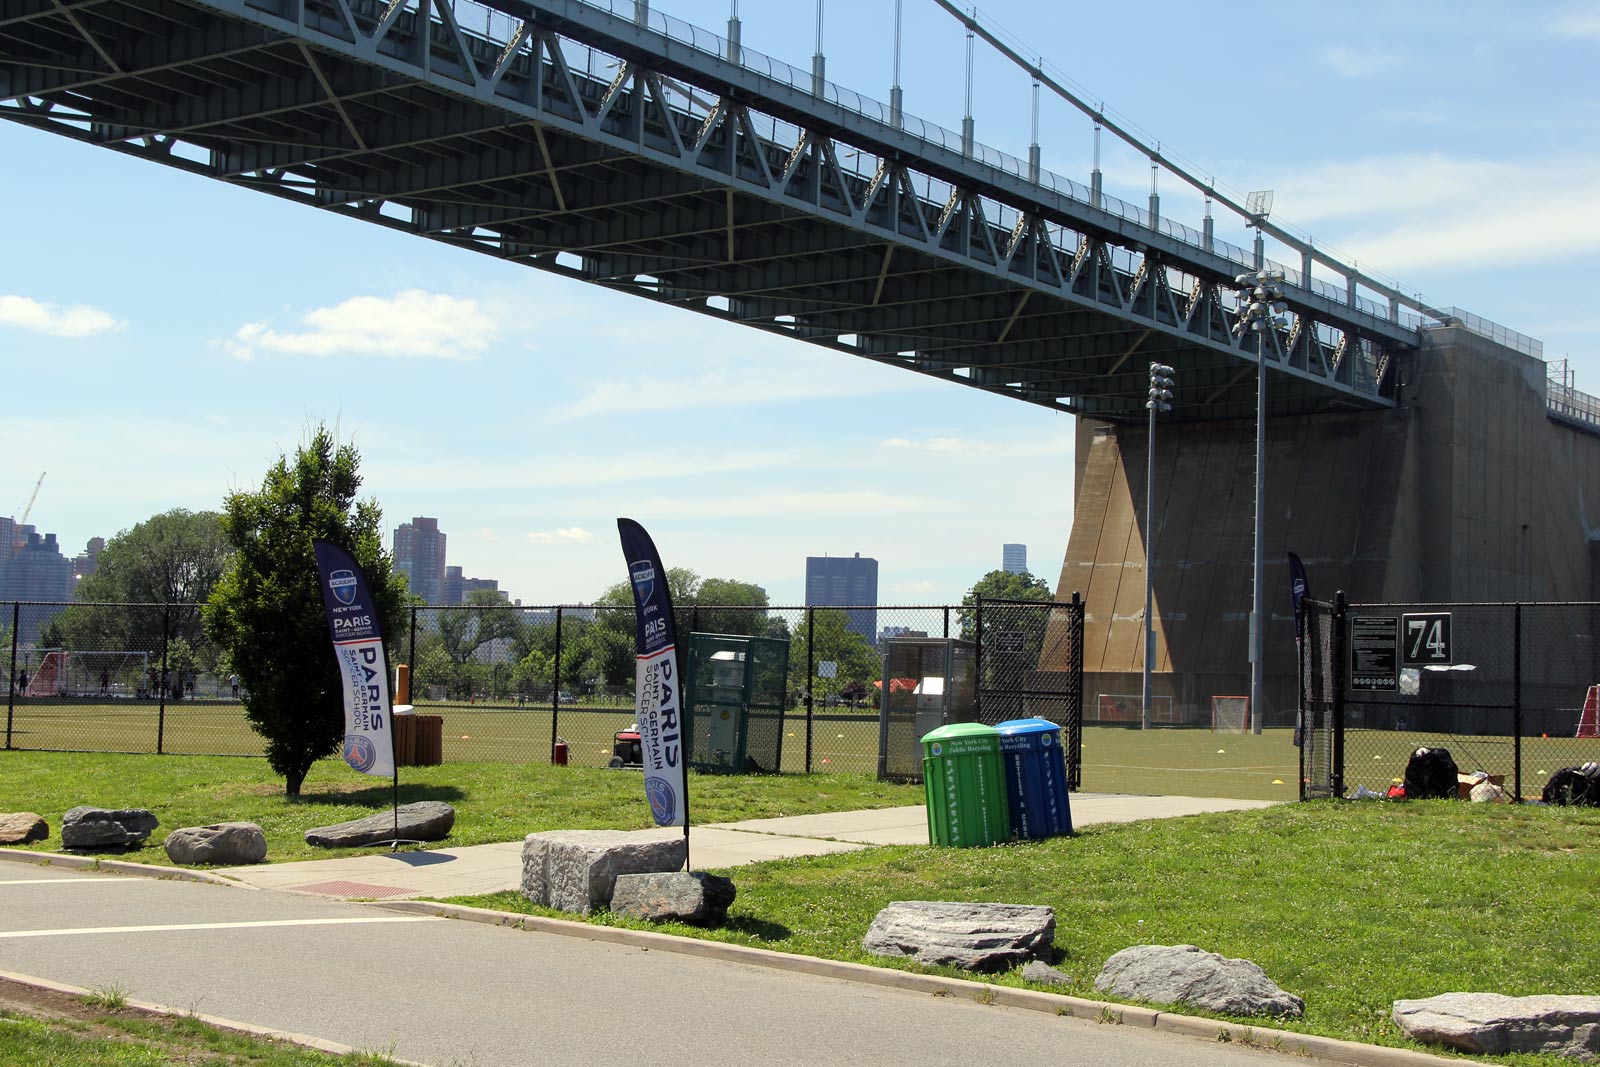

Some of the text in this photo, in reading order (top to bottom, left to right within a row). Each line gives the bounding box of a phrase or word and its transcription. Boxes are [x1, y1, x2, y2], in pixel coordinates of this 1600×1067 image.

[331, 578, 355, 586] ACADEMY
[334, 615, 371, 629] PARIS
[1408, 619, 1446, 658] 74
[349, 649, 362, 678] SAINT
[360, 685, 370, 731] GERMAIN
[359, 647, 383, 731] PARIS
[640, 665, 653, 715] SOCCER
[652, 663, 660, 701] SAINT
[352, 689, 362, 732] SCHOOL
[660, 658, 679, 768] PARIS
[649, 711, 663, 770] GERMAIN
[949, 746, 966, 754] Public
[967, 745, 991, 753] Recycling
[1004, 743, 1031, 751] Recycling
